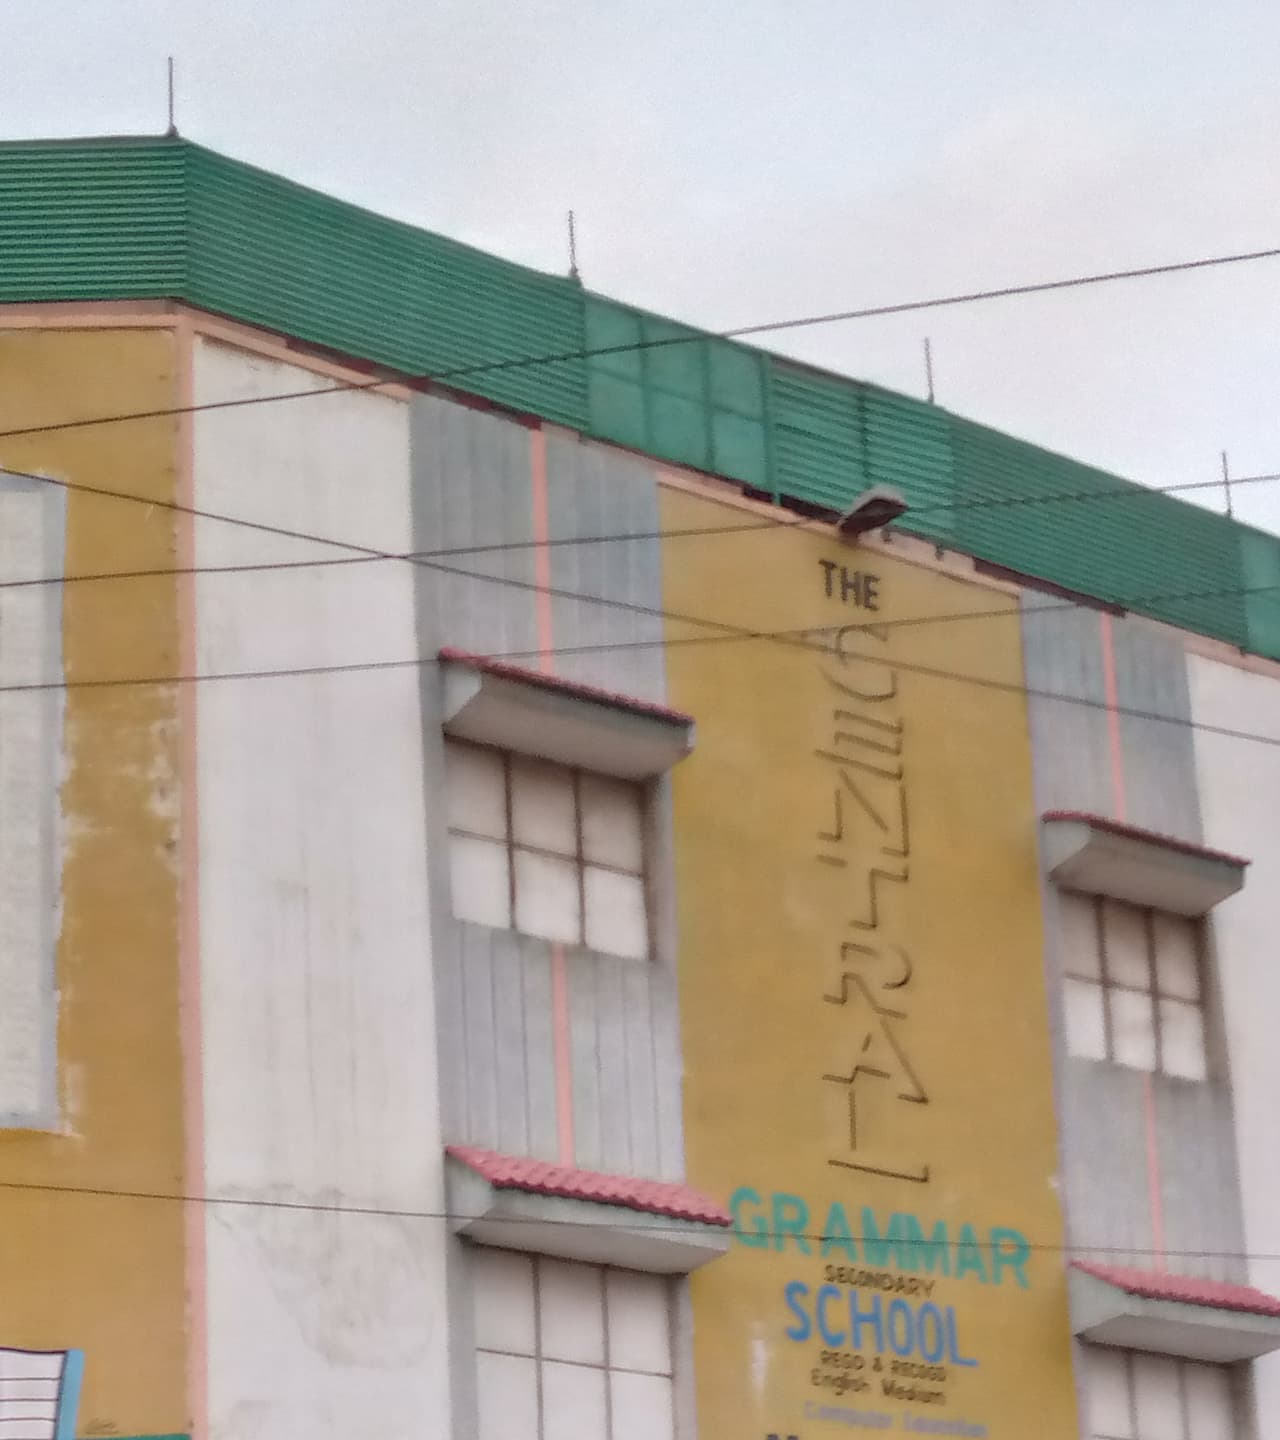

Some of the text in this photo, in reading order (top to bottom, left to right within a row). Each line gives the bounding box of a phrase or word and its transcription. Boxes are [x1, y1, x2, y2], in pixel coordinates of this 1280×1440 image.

[818, 558, 880, 612] THE
[728, 1186, 1031, 1290] GRAMMAR
[823, 1263, 936, 1299] SECONDARY
[783, 1280, 980, 1368] SCHOOL
